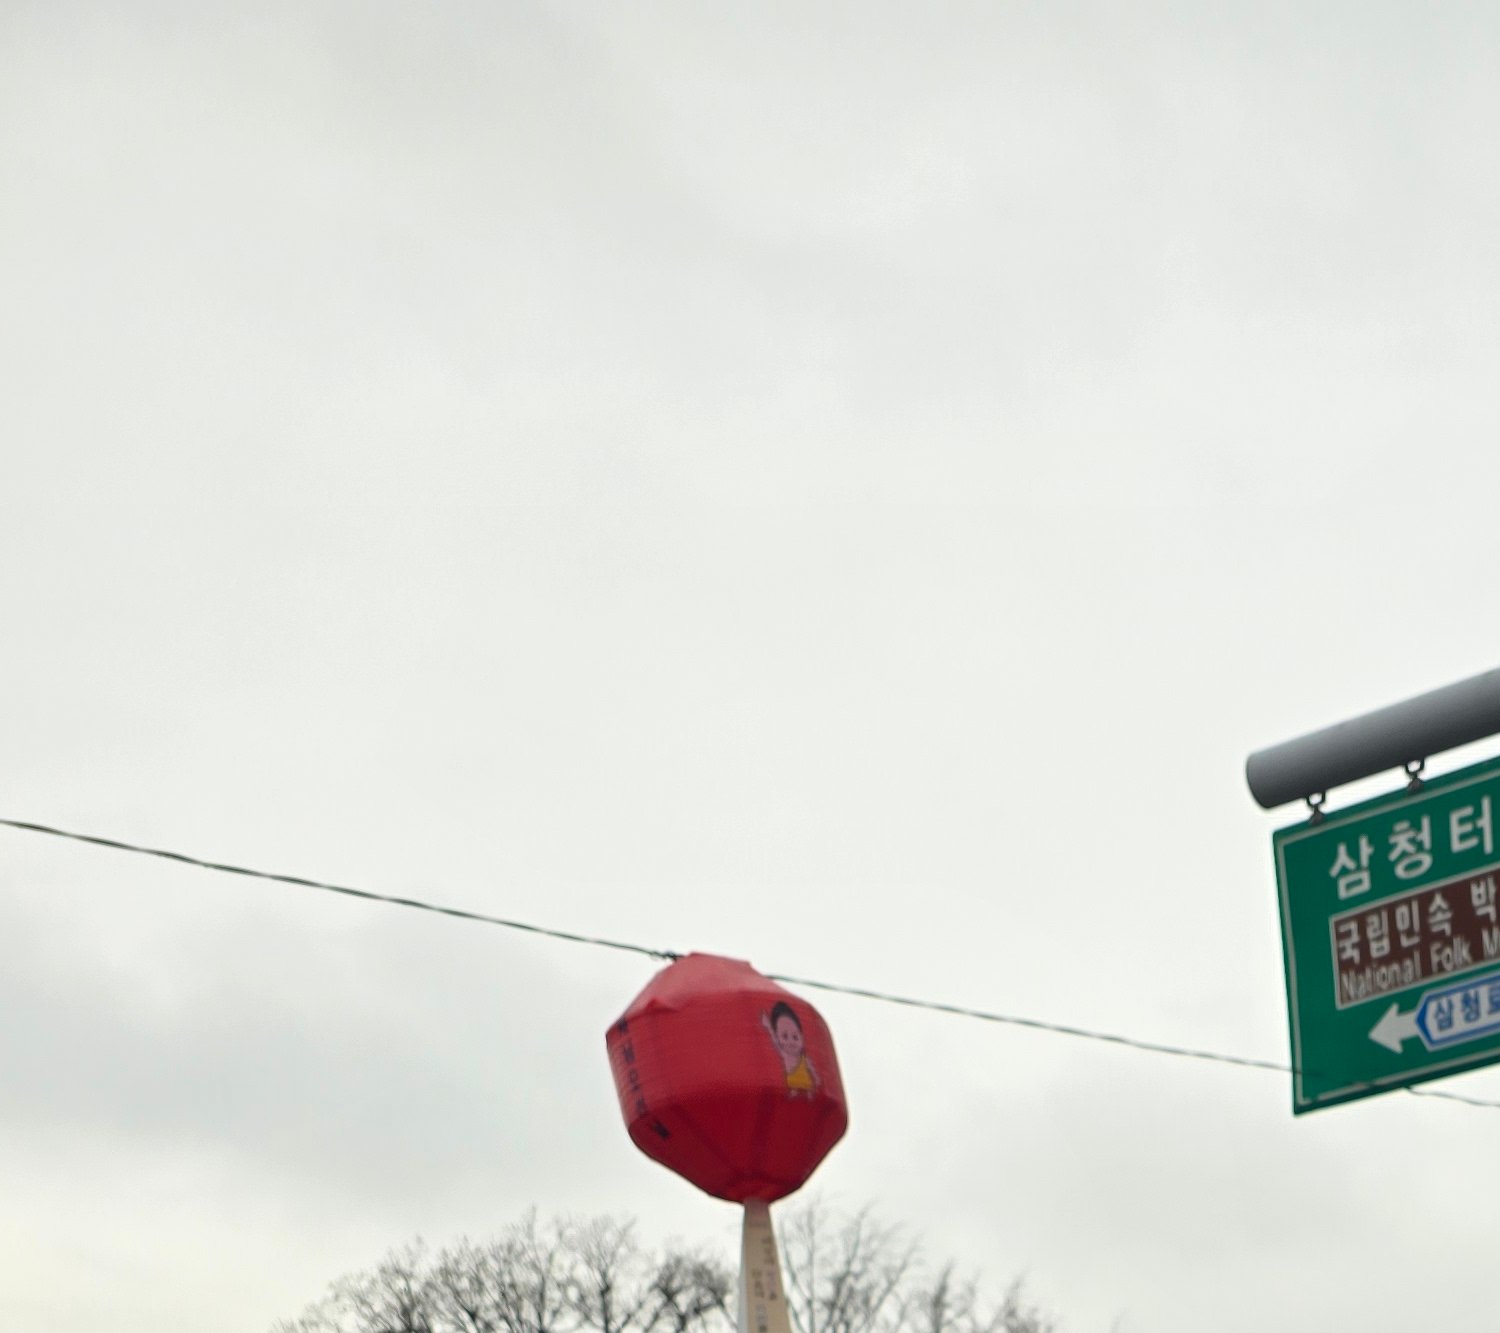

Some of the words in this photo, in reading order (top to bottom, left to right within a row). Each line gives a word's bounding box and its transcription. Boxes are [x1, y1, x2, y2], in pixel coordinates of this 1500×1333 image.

[1337, 892, 1453, 966] 국립민속
[1341, 952, 1423, 1001] National
[1430, 936, 1473, 973] Folk
